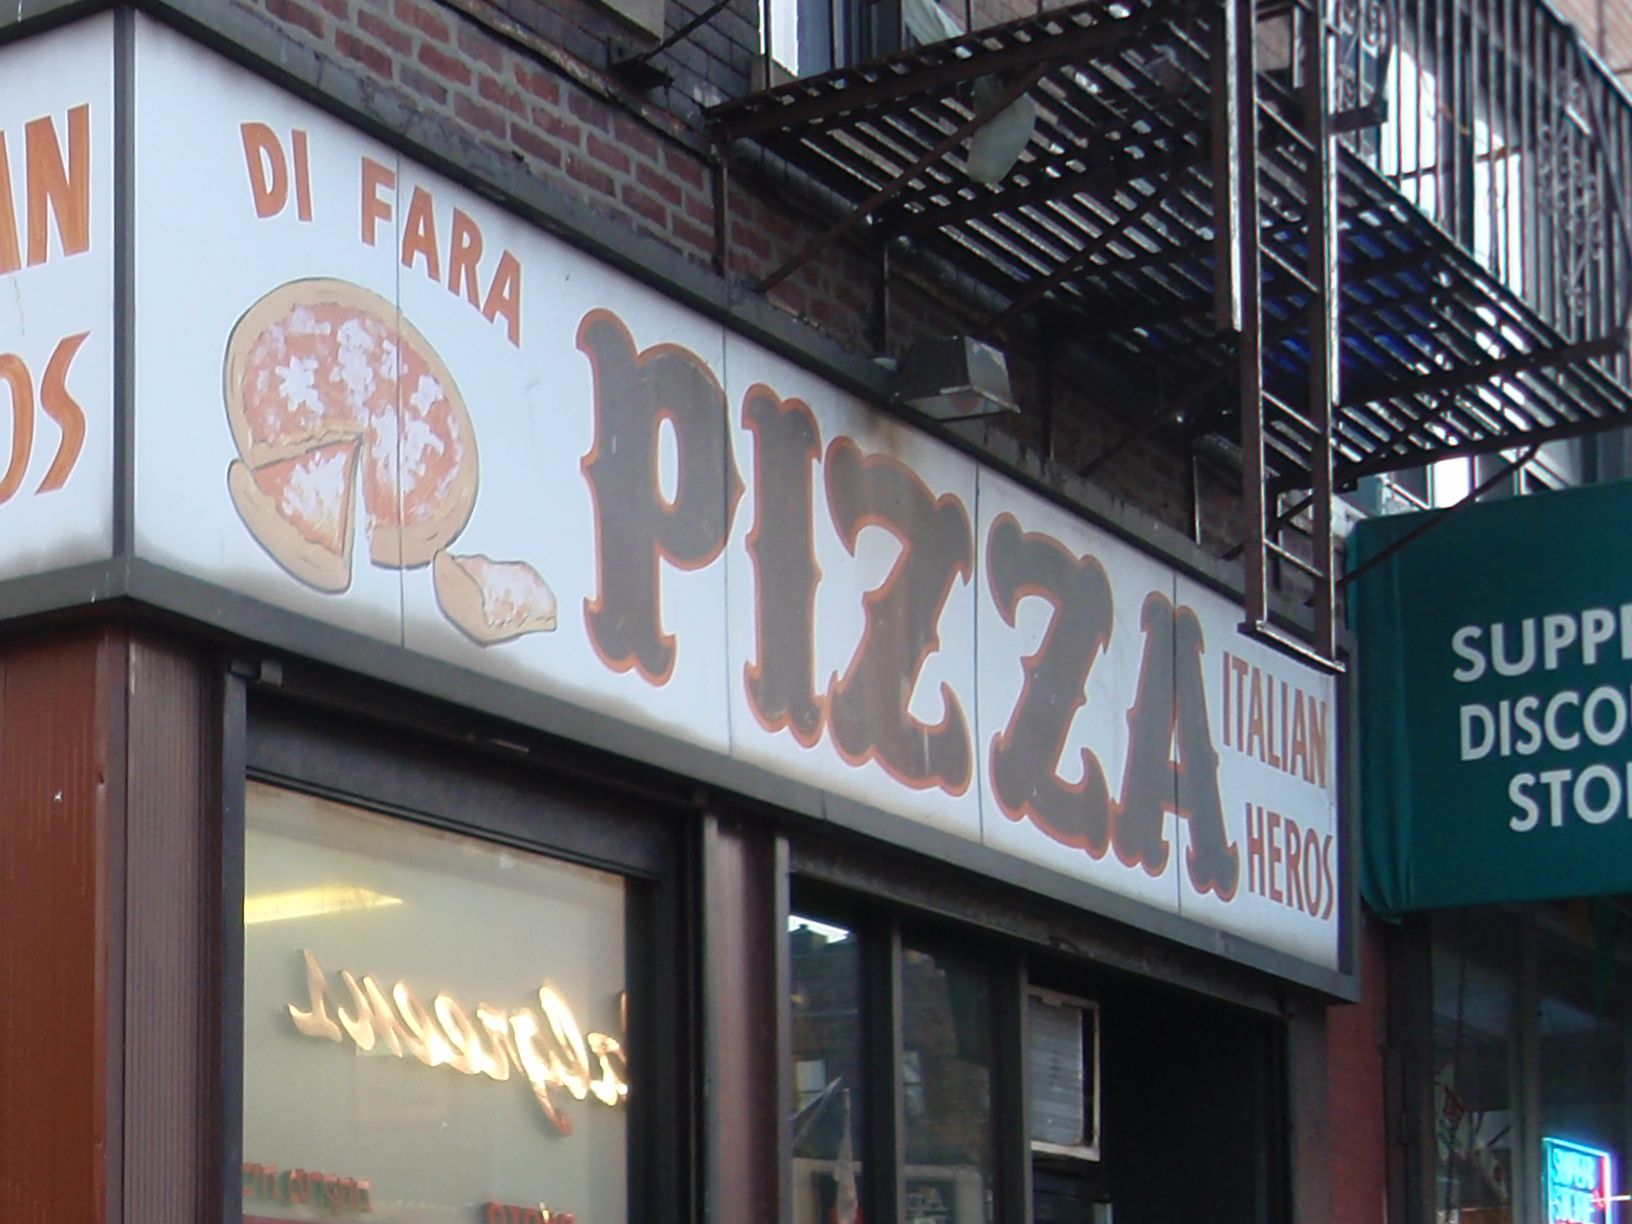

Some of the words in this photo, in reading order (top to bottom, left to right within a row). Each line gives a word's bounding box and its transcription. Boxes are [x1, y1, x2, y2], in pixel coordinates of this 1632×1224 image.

[241, 122, 312, 222] DI
[361, 157, 521, 348] FARA
[575, 308, 1240, 901] PIZZA
[1223, 651, 1326, 789] ITALIAN
[1460, 684, 1632, 761] DISCO
[1246, 802, 1333, 920] HEROS
[1508, 762, 1632, 832] STO
